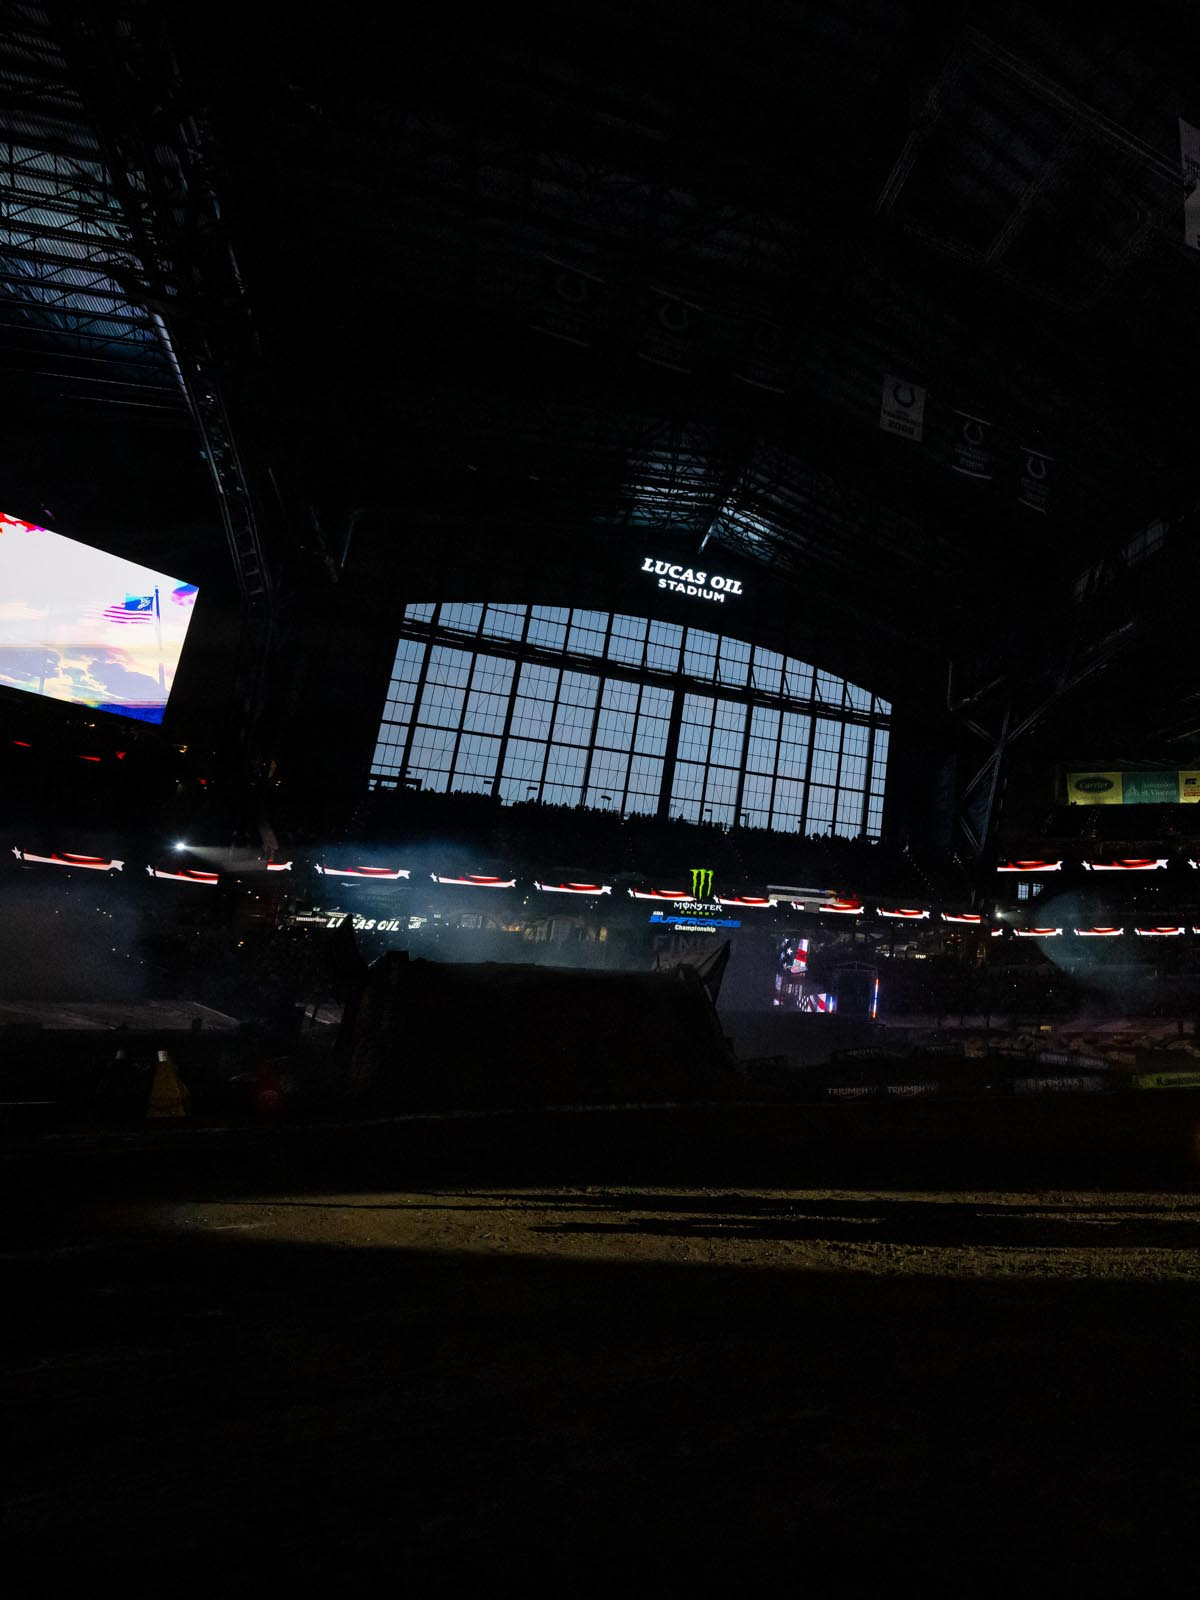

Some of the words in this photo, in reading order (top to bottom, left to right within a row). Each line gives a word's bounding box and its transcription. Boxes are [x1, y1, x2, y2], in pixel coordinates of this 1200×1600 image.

[641, 557, 707, 585] LUCAS
[710, 575, 743, 595] OIL
[658, 578, 725, 603] STADIUM
[377, 919, 400, 932] OIL
[674, 924, 717, 933] Championship
